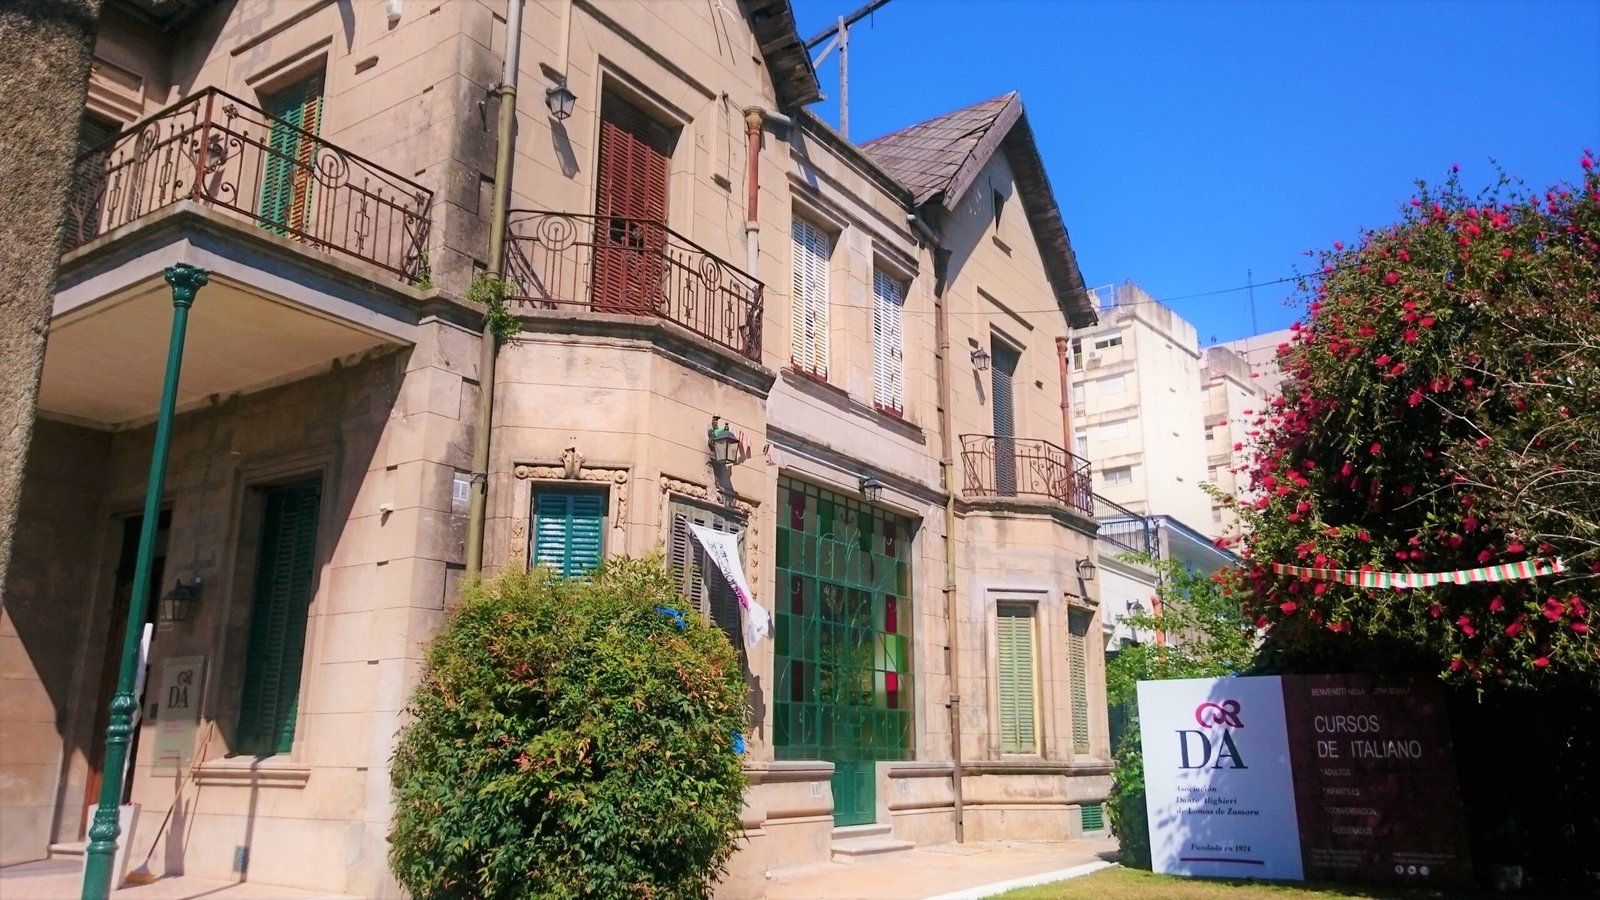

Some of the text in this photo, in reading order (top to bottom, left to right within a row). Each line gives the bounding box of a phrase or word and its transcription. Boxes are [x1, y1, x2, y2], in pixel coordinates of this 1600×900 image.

[168, 686, 189, 709] DA
[1311, 688, 1347, 697] BENVENUTI
[1314, 715, 1380, 733] CURSOS
[1176, 728, 1249, 769] DA
[1317, 740, 1422, 759] DE ITALIANO
[1324, 768, 1351, 777] ADULTOS
[1326, 786, 1361, 797] INFANTILES
[1176, 796, 1200, 804] Dante
[1176, 807, 1260, 816] de Lomas de Zamora
[1191, 843, 1223, 852] Fundada
[1224, 845, 1234, 853] en
